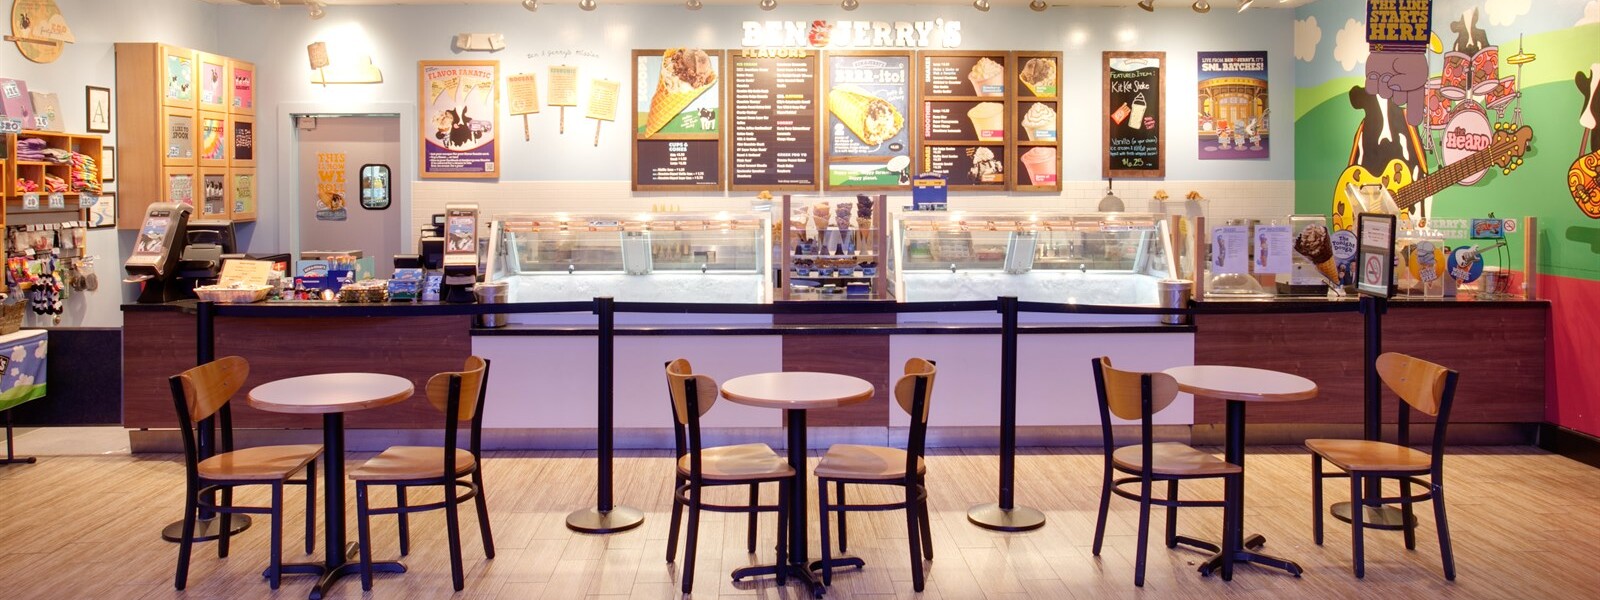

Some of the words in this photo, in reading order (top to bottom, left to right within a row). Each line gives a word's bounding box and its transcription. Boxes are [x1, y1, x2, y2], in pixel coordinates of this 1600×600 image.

[1370, 0, 1396, 10] THE
[1399, 0, 1429, 10] LINE
[1370, 10, 1428, 23] STARTS
[741, 21, 807, 47] BEN
[831, 17, 961, 48] JERRY'S
[1369, 23, 1428, 40] HERE
[741, 49, 807, 59] FLAVORS
[1201, 62, 1222, 72] SNL
[1222, 62, 1265, 71] BATCHES!
[428, 69, 457, 80] FLAVOR
[459, 69, 491, 79] FANATIC
[318, 153, 345, 162] THIS
[318, 170, 346, 182] WE
[1332, 240, 1355, 249] Tonight
[1334, 245, 1353, 253] Dough
